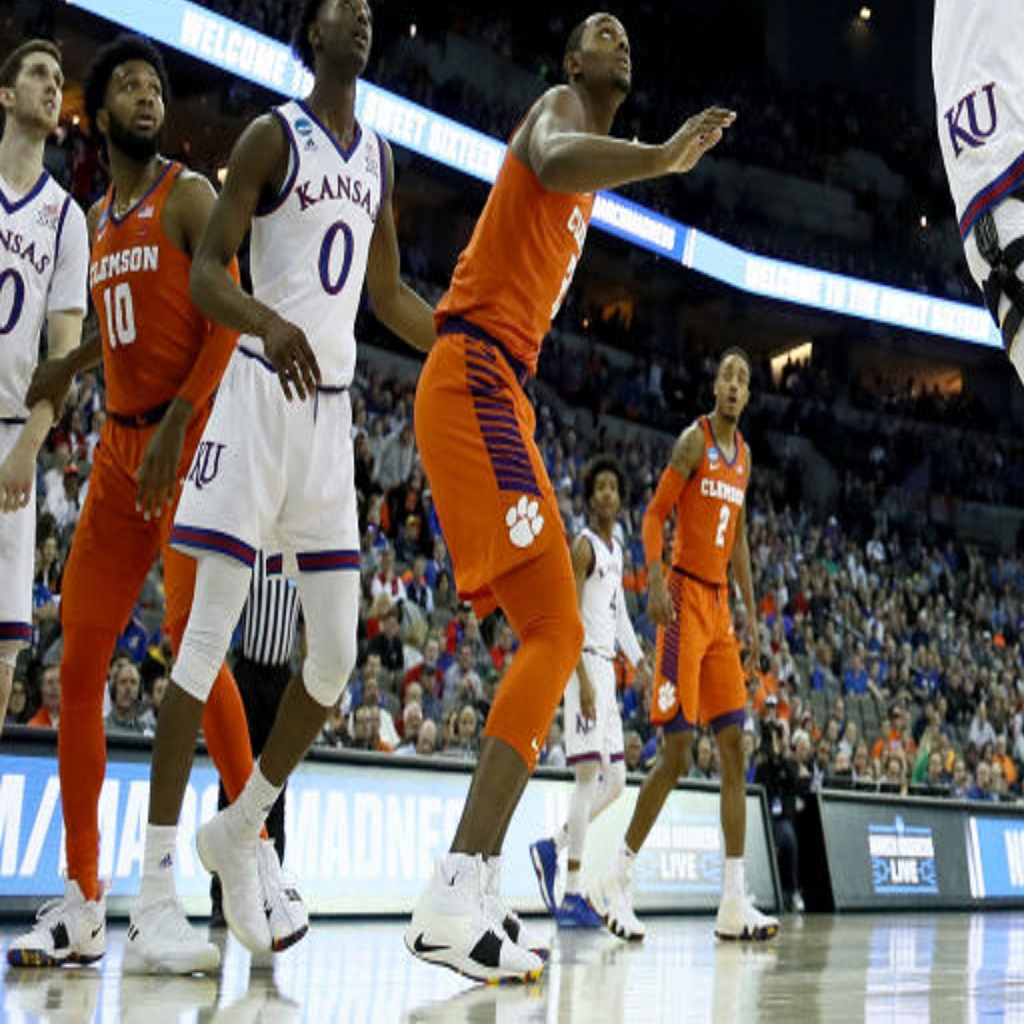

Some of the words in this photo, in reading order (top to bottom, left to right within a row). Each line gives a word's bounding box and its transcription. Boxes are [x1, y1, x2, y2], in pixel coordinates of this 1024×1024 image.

[944, 82, 997, 158] KU
[318, 219, 355, 296] 0
[103, 282, 137, 350] 10
[715, 505, 731, 548] 2
